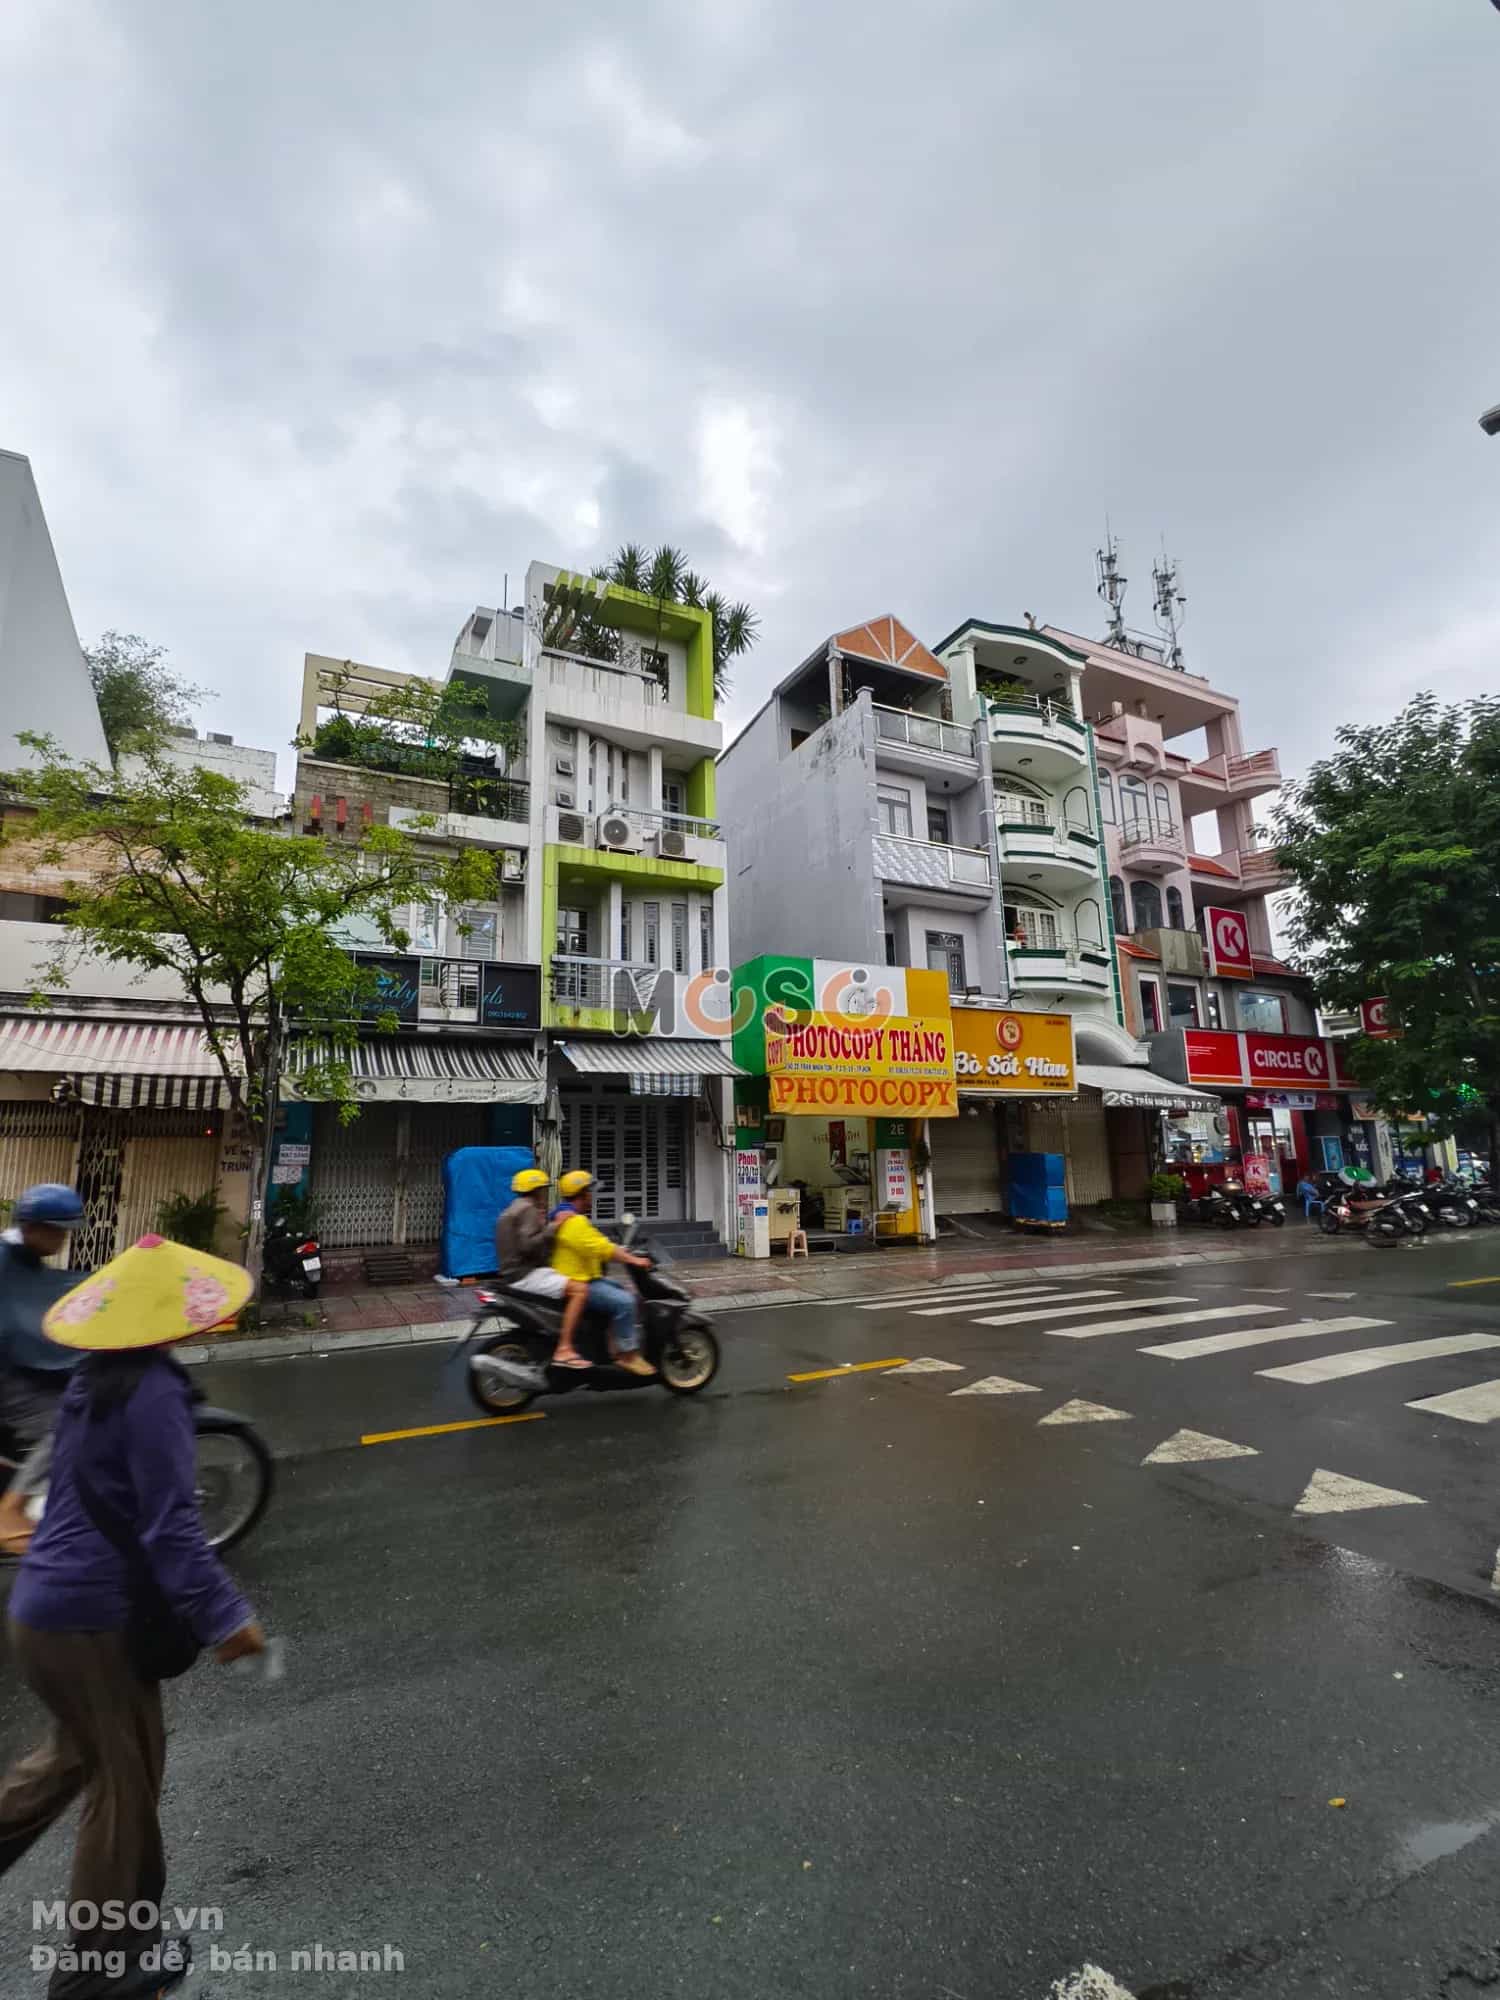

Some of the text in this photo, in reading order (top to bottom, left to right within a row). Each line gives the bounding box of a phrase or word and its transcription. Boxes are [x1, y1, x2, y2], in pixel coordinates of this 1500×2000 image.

[888, 1020, 947, 1063] THẮNG
[1253, 1047, 1322, 1075] CIRCLE K
[774, 1076, 953, 1106] PHOTOCOPY
